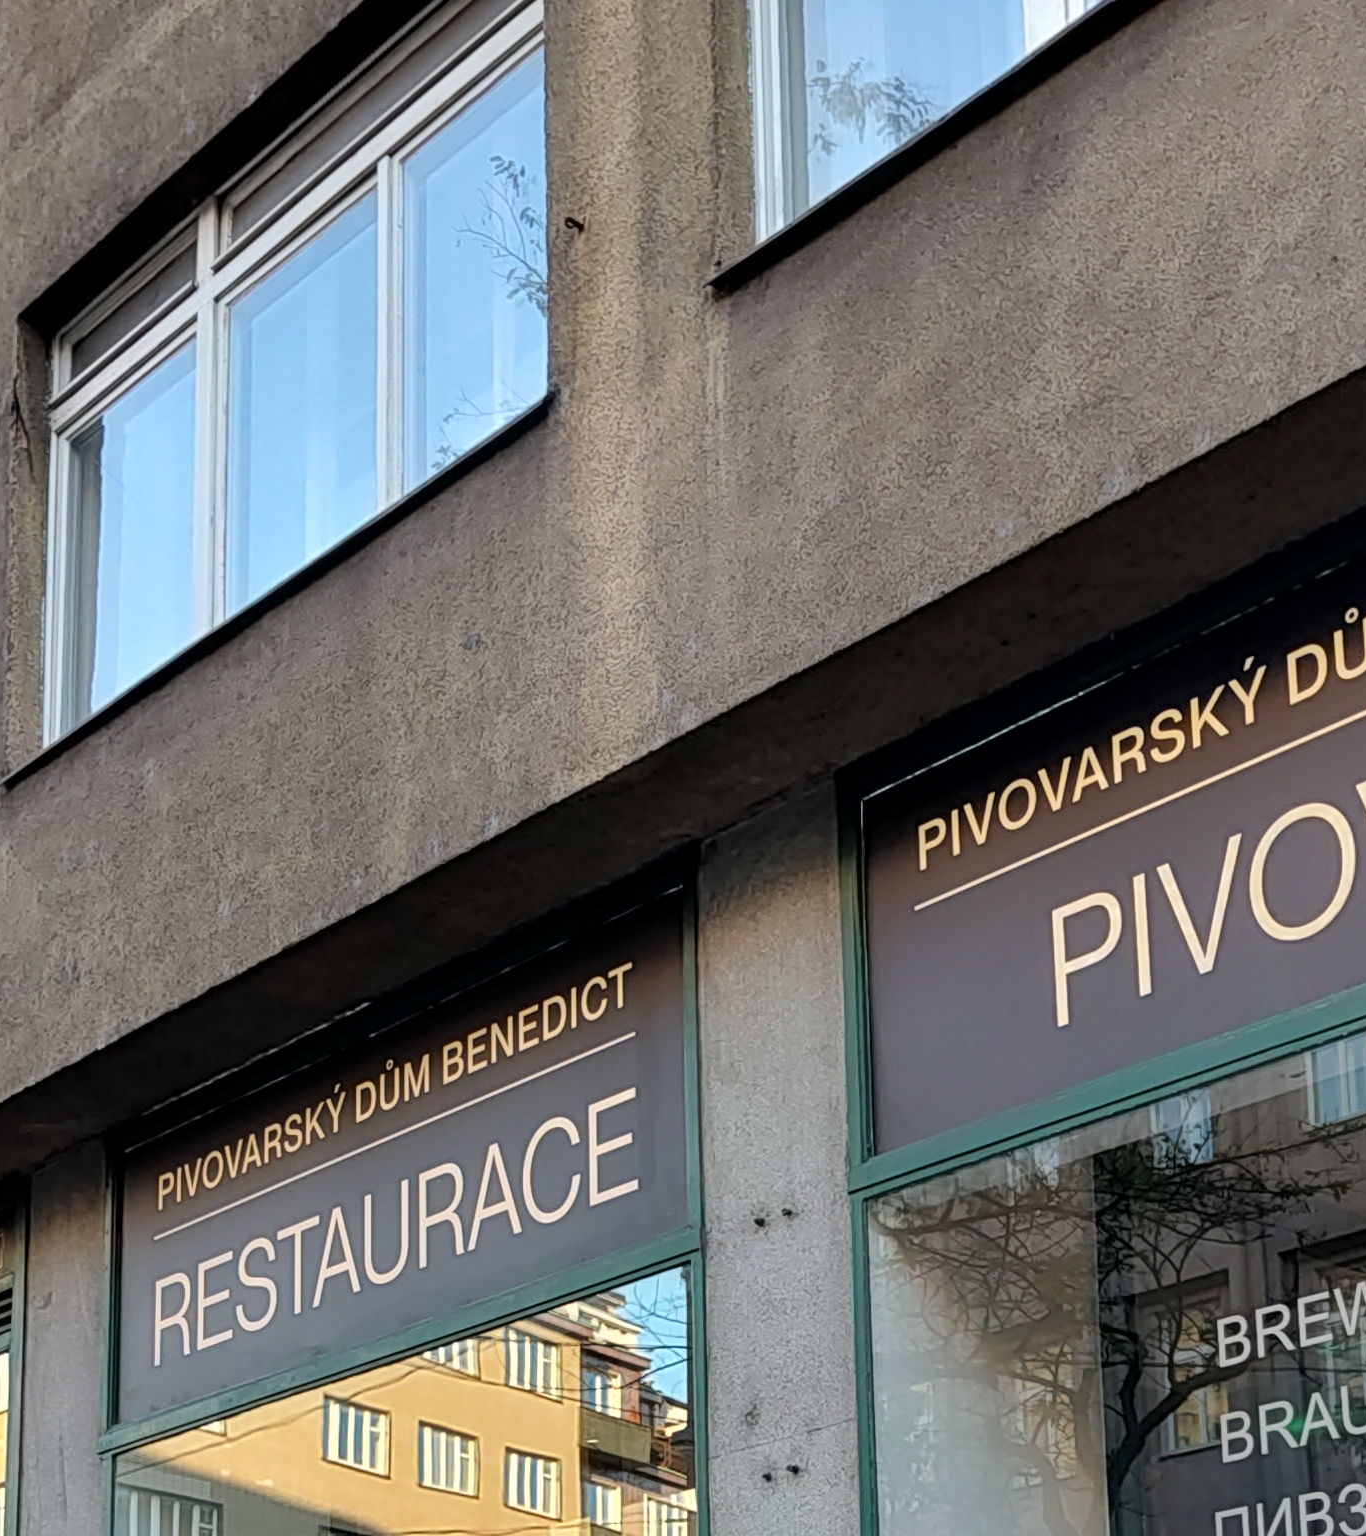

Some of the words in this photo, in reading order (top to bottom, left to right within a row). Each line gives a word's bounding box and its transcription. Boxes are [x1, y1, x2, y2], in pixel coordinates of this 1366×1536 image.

[914, 655, 1269, 873] PIVOVARSKÝ
[156, 1084, 348, 1212] PIVOVARSKÝ
[354, 1059, 431, 1125] DŮM
[441, 962, 634, 1086] BENEDICT
[152, 1087, 640, 1367] RESTAURACE
